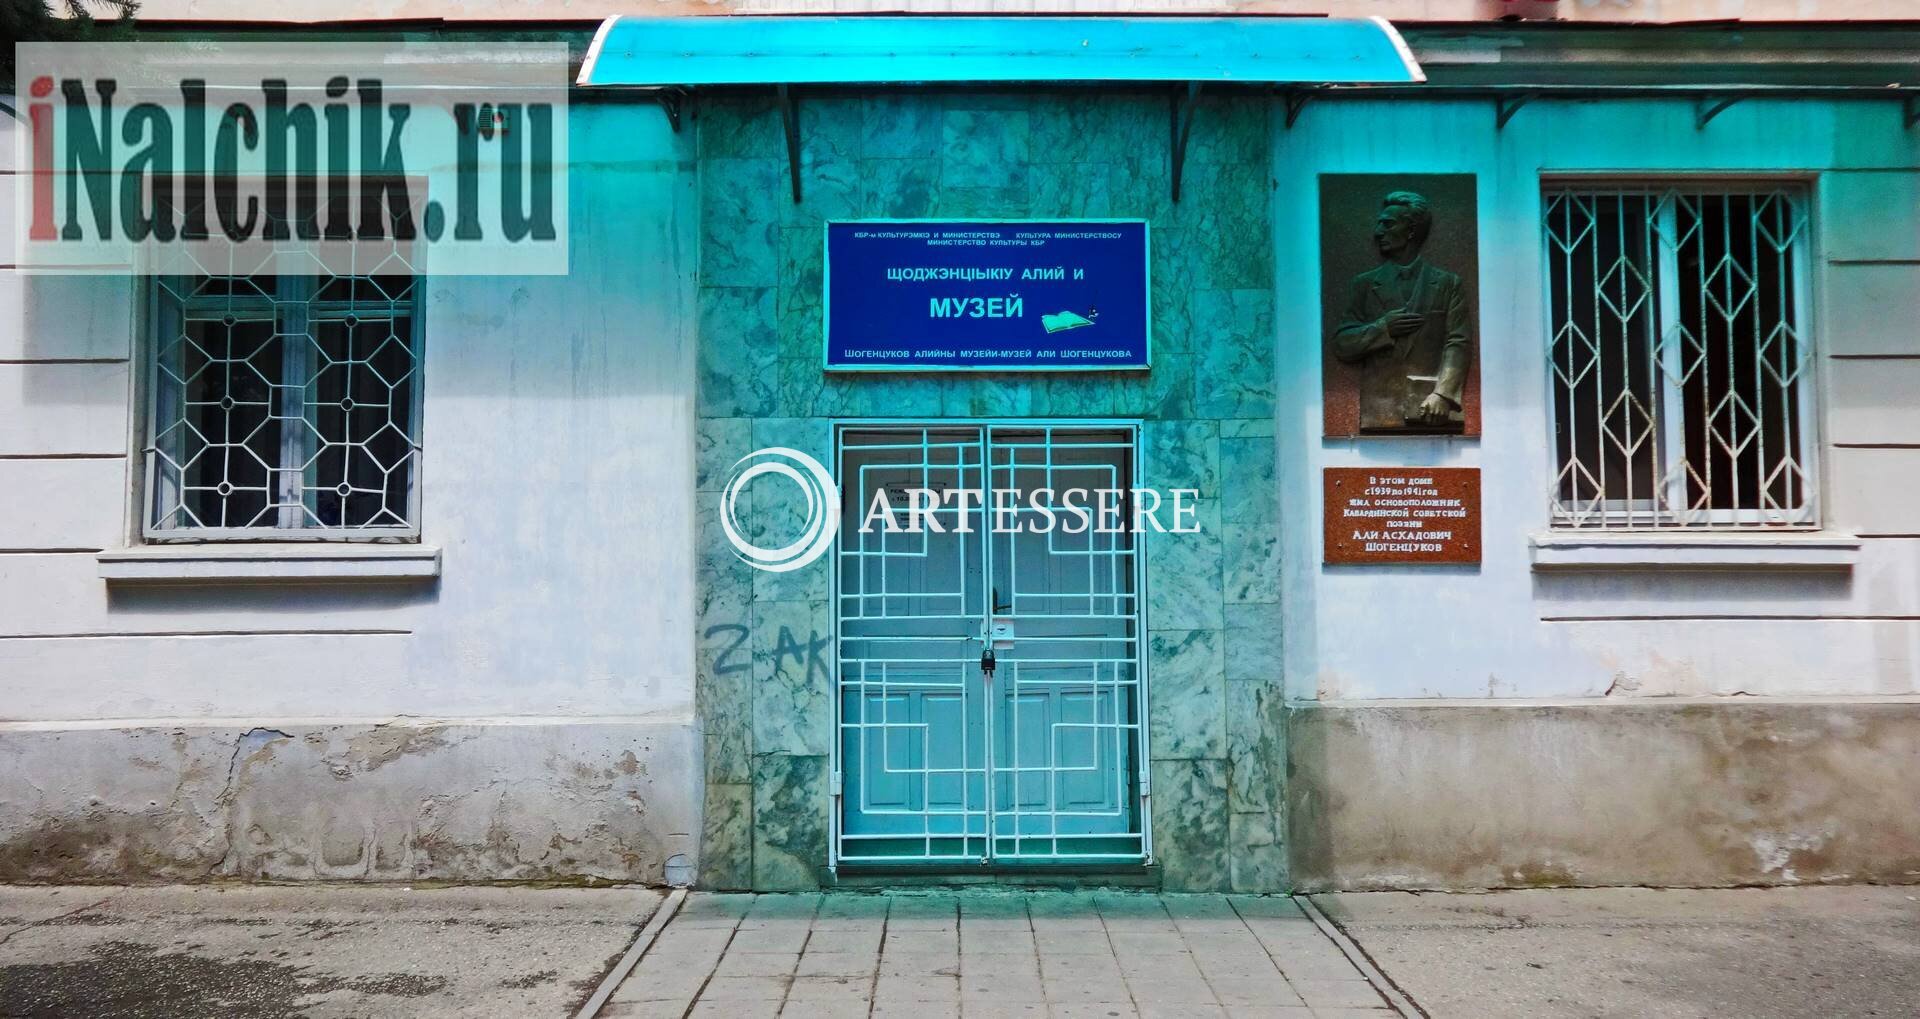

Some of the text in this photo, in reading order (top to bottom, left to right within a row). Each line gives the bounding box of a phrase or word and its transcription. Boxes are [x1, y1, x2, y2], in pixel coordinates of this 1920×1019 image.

[1022, 266, 1064, 280] АЛИЙ
[1074, 269, 1084, 280] И
[930, 294, 1023, 318] МУЗЕЙ
[844, 350, 909, 358] ШОГЕНЦУКОВ
[1061, 350, 1131, 358] ШОГЕНЦУКОВА
[1353, 531, 1451, 540] АЛИ АСХАДОВИЧ
[1365, 543, 1442, 552] ШОГЕНЦУКОВ
